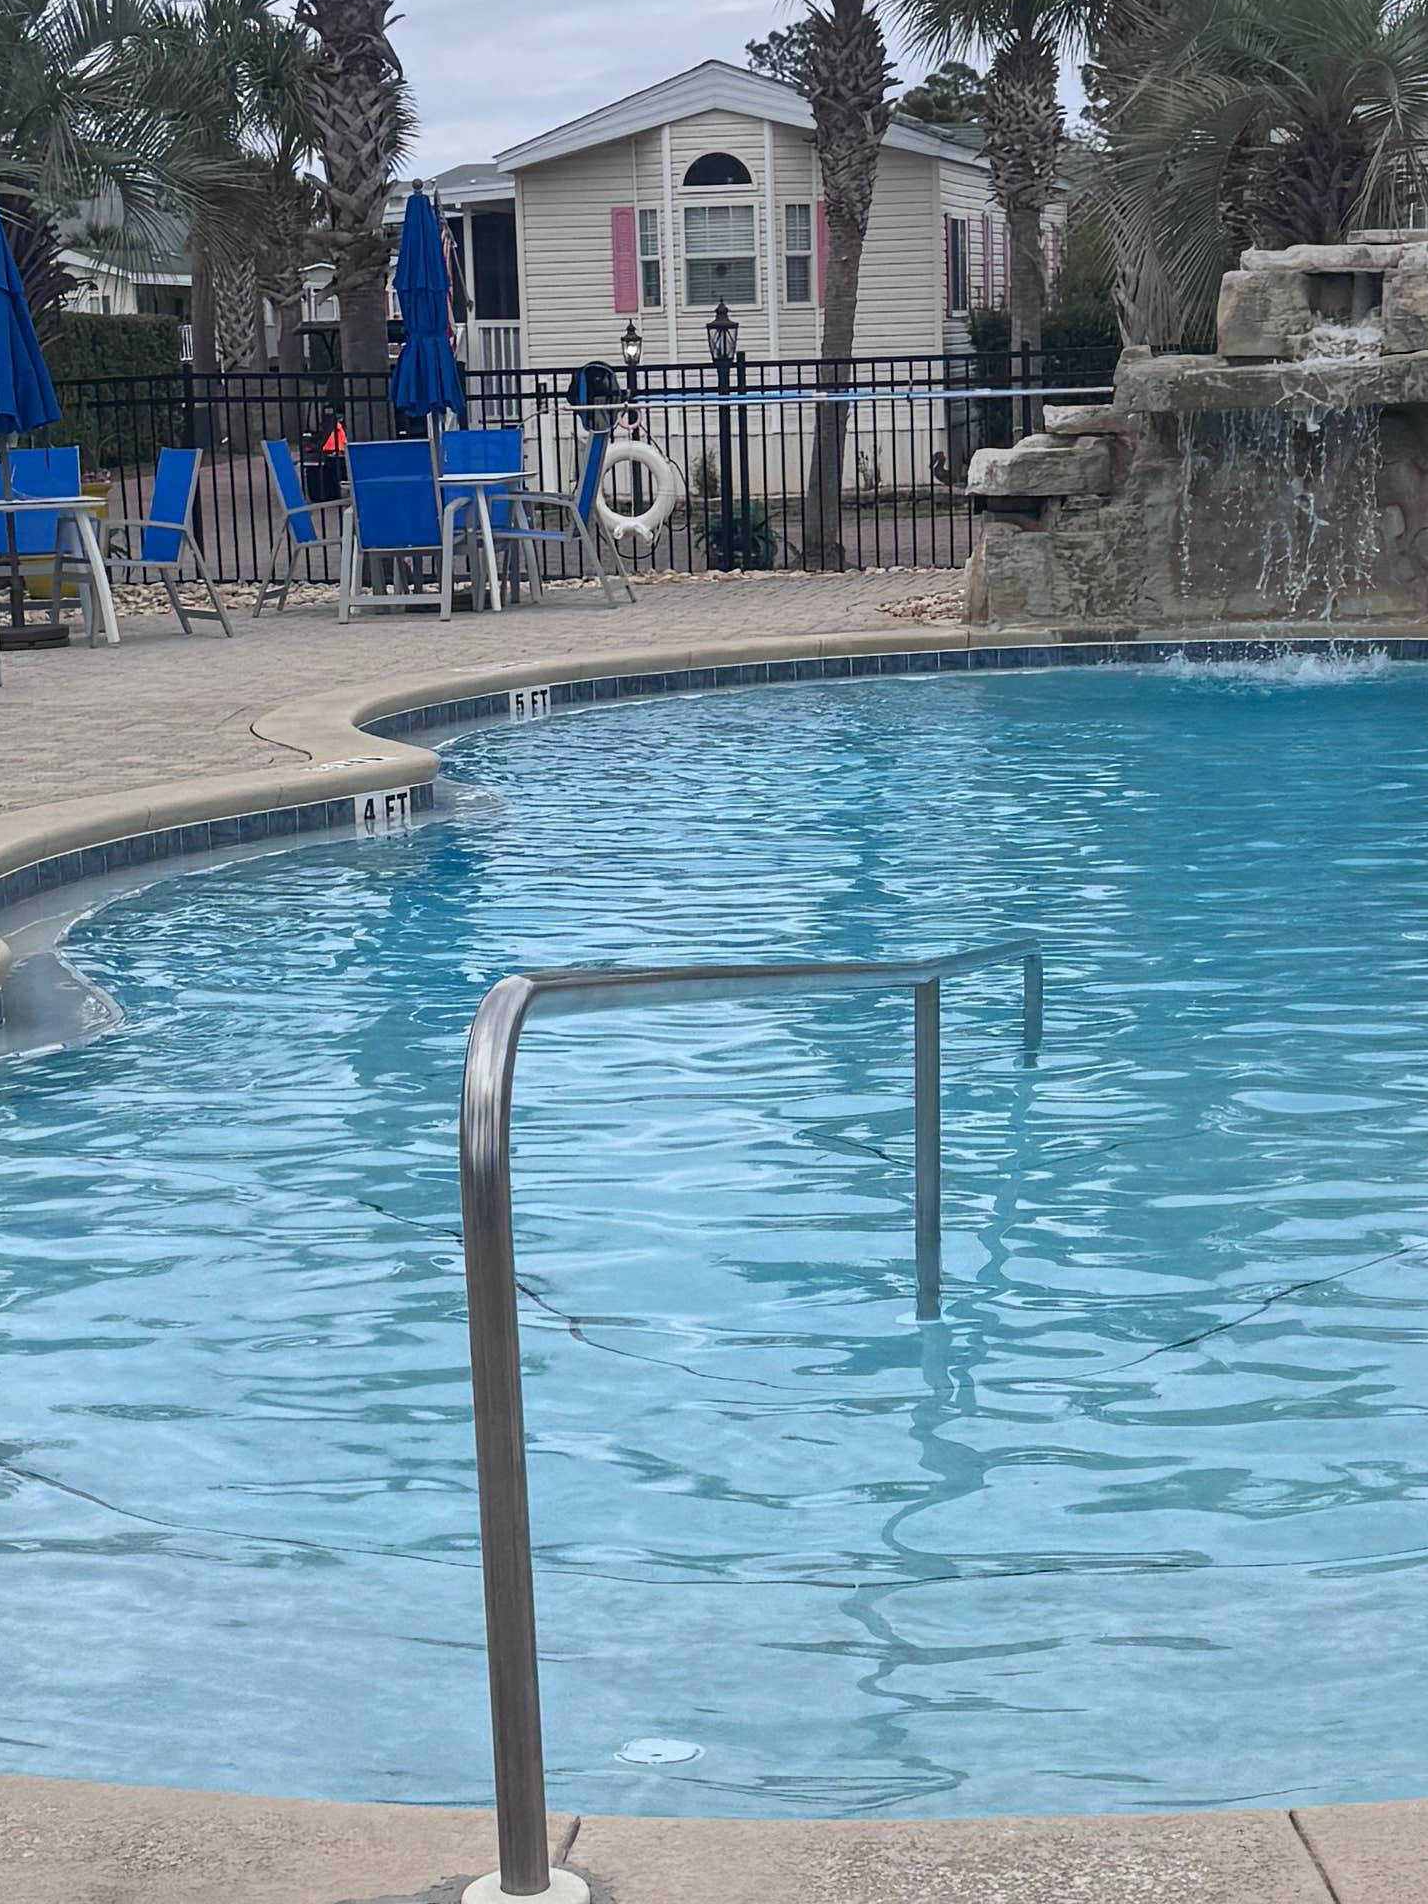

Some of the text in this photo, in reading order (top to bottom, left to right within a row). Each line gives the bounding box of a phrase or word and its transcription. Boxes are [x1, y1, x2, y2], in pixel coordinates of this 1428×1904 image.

[515, 690, 548, 709] 5 FT
[364, 792, 408, 820] 4 FT
